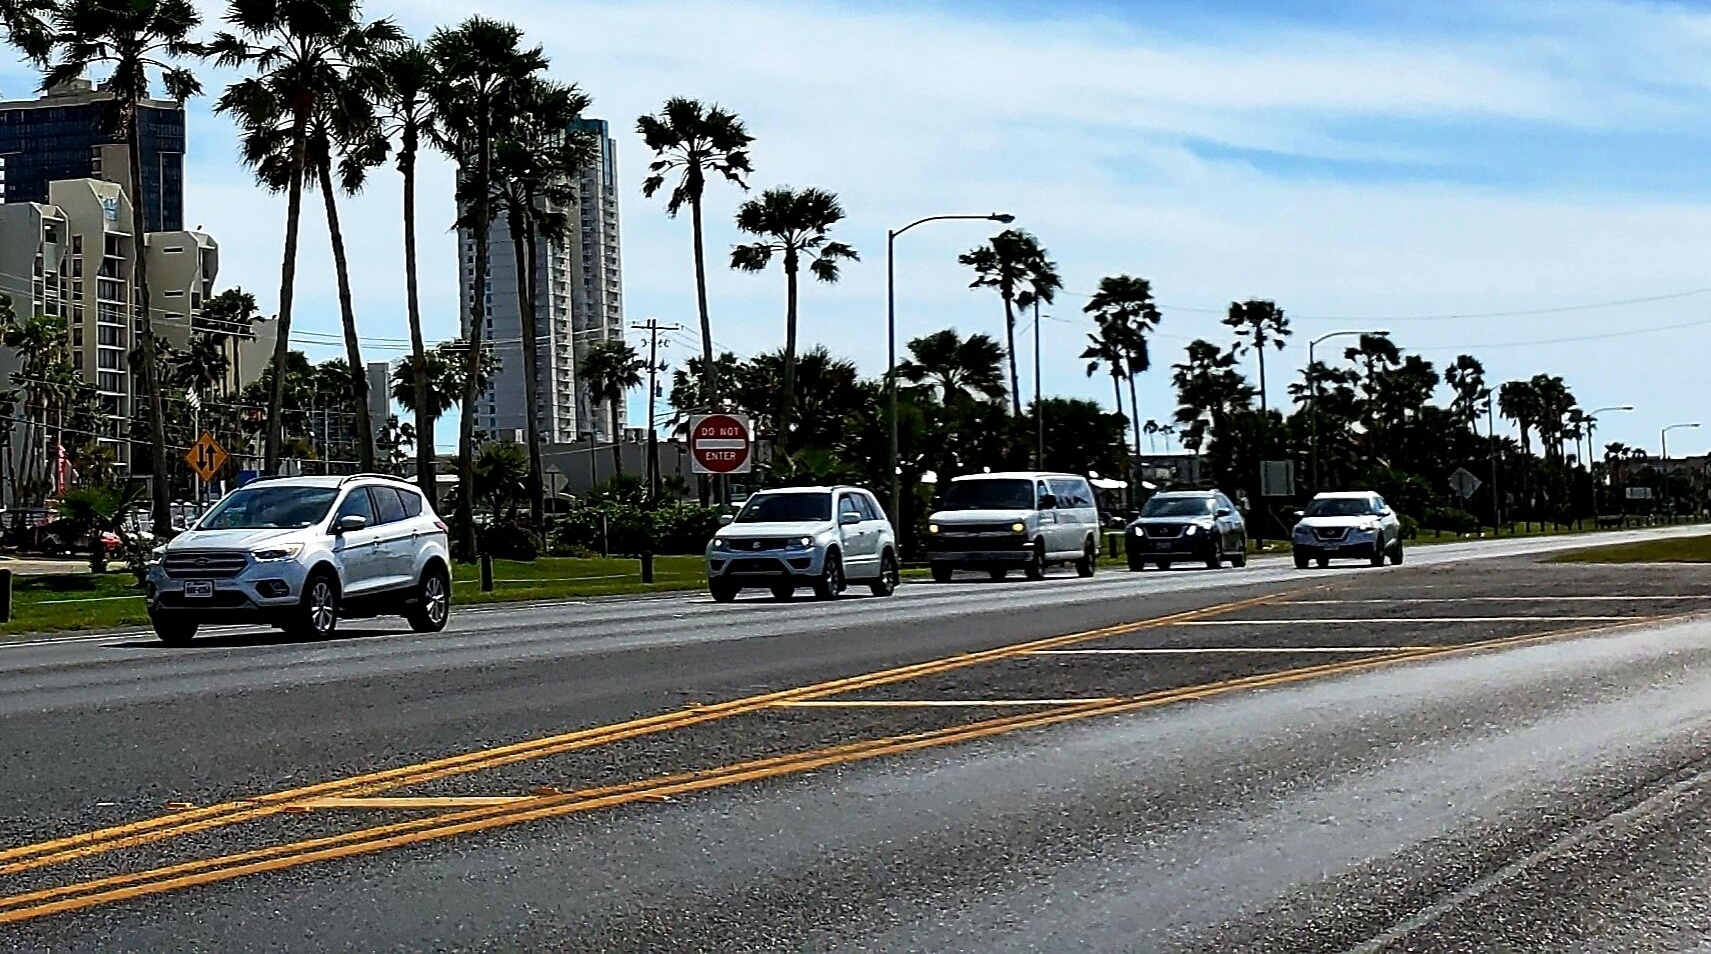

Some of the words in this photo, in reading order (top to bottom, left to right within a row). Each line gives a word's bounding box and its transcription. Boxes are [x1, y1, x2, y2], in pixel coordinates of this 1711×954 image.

[701, 427, 715, 436] DO
[719, 427, 739, 436] NOT
[705, 451, 737, 461] ENTER
